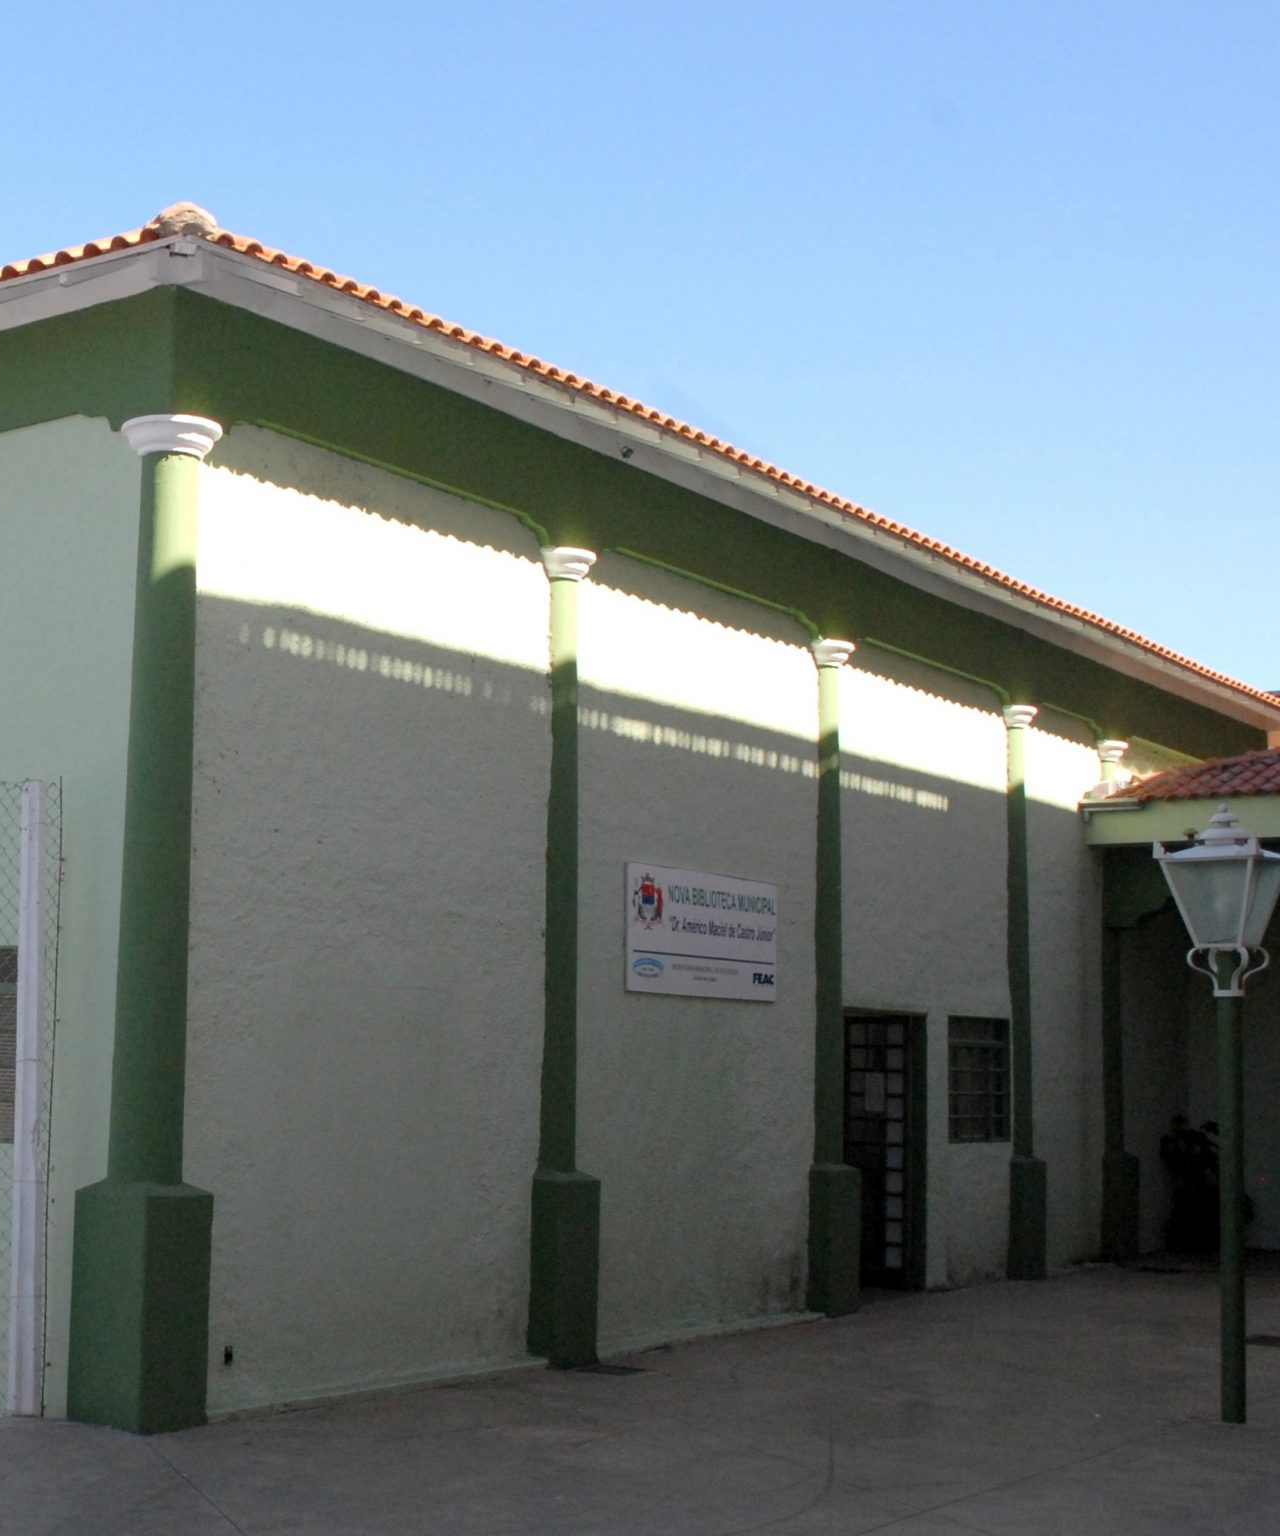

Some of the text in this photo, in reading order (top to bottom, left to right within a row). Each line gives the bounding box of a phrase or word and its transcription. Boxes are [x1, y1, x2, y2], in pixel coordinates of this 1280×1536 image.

[668, 885, 776, 915] NOVA BIBLIOTECA MUNICIPAL
[708, 920, 727, 937] Maciel
[728, 923, 736, 938] de
[737, 923, 755, 940] Castro
[752, 973, 775, 985] FEAC
